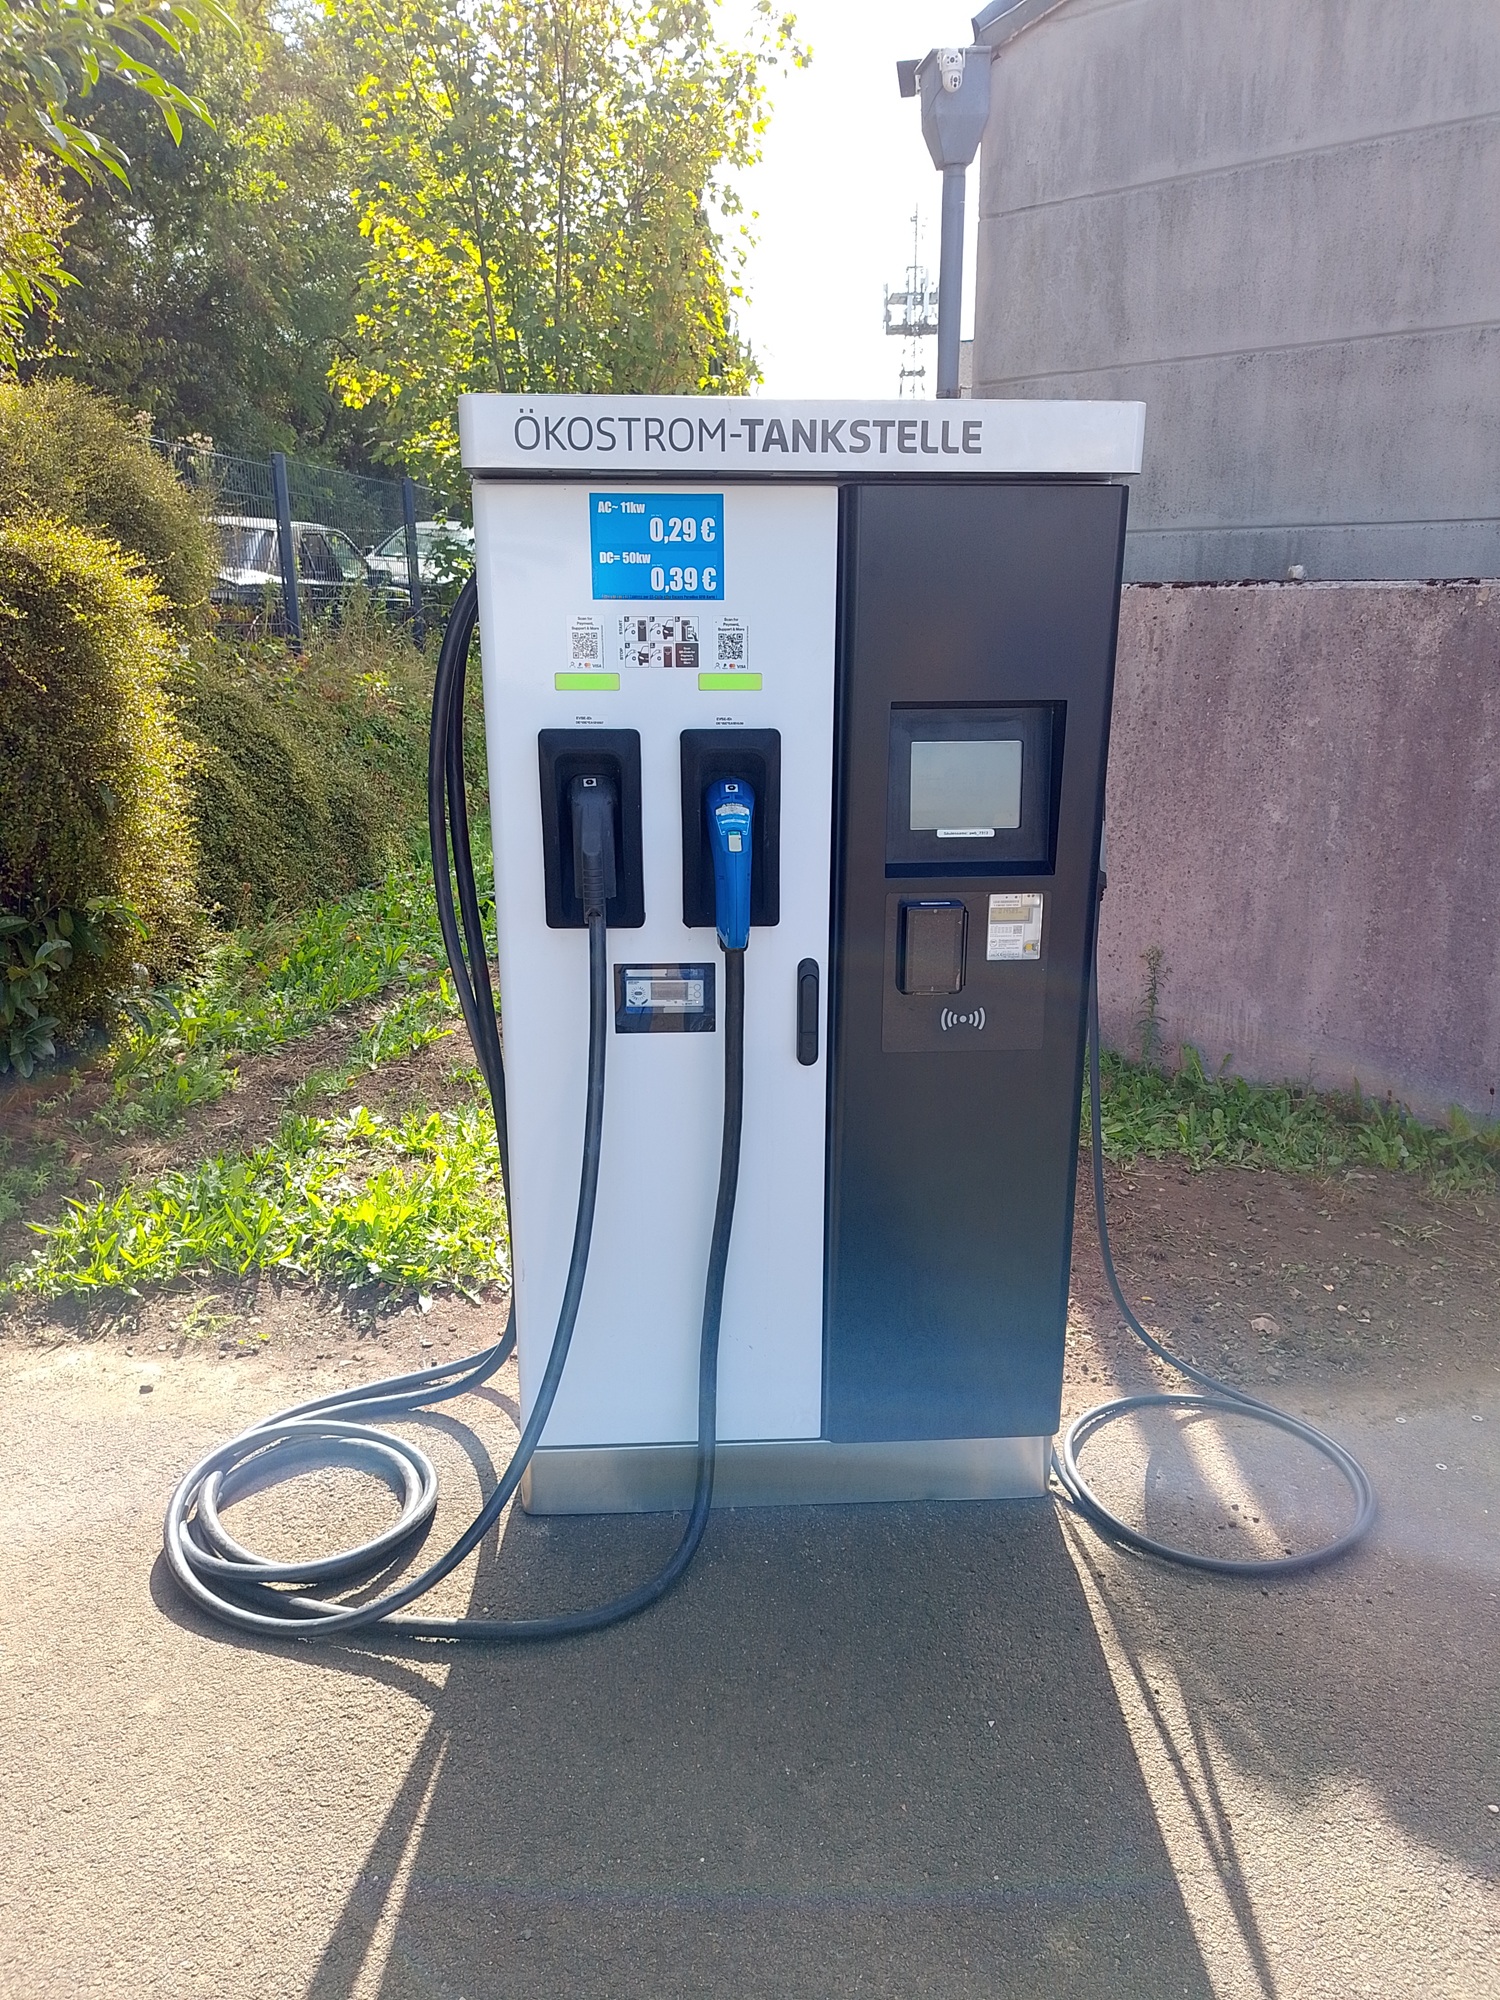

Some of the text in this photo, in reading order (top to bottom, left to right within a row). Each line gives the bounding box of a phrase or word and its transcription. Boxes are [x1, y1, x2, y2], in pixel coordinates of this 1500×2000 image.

[513, 407, 983, 454] ÖKOSTROM-TANKSTELLE
[650, 517, 716, 544] 0,29 €
[651, 567, 717, 593] 0,39 €
